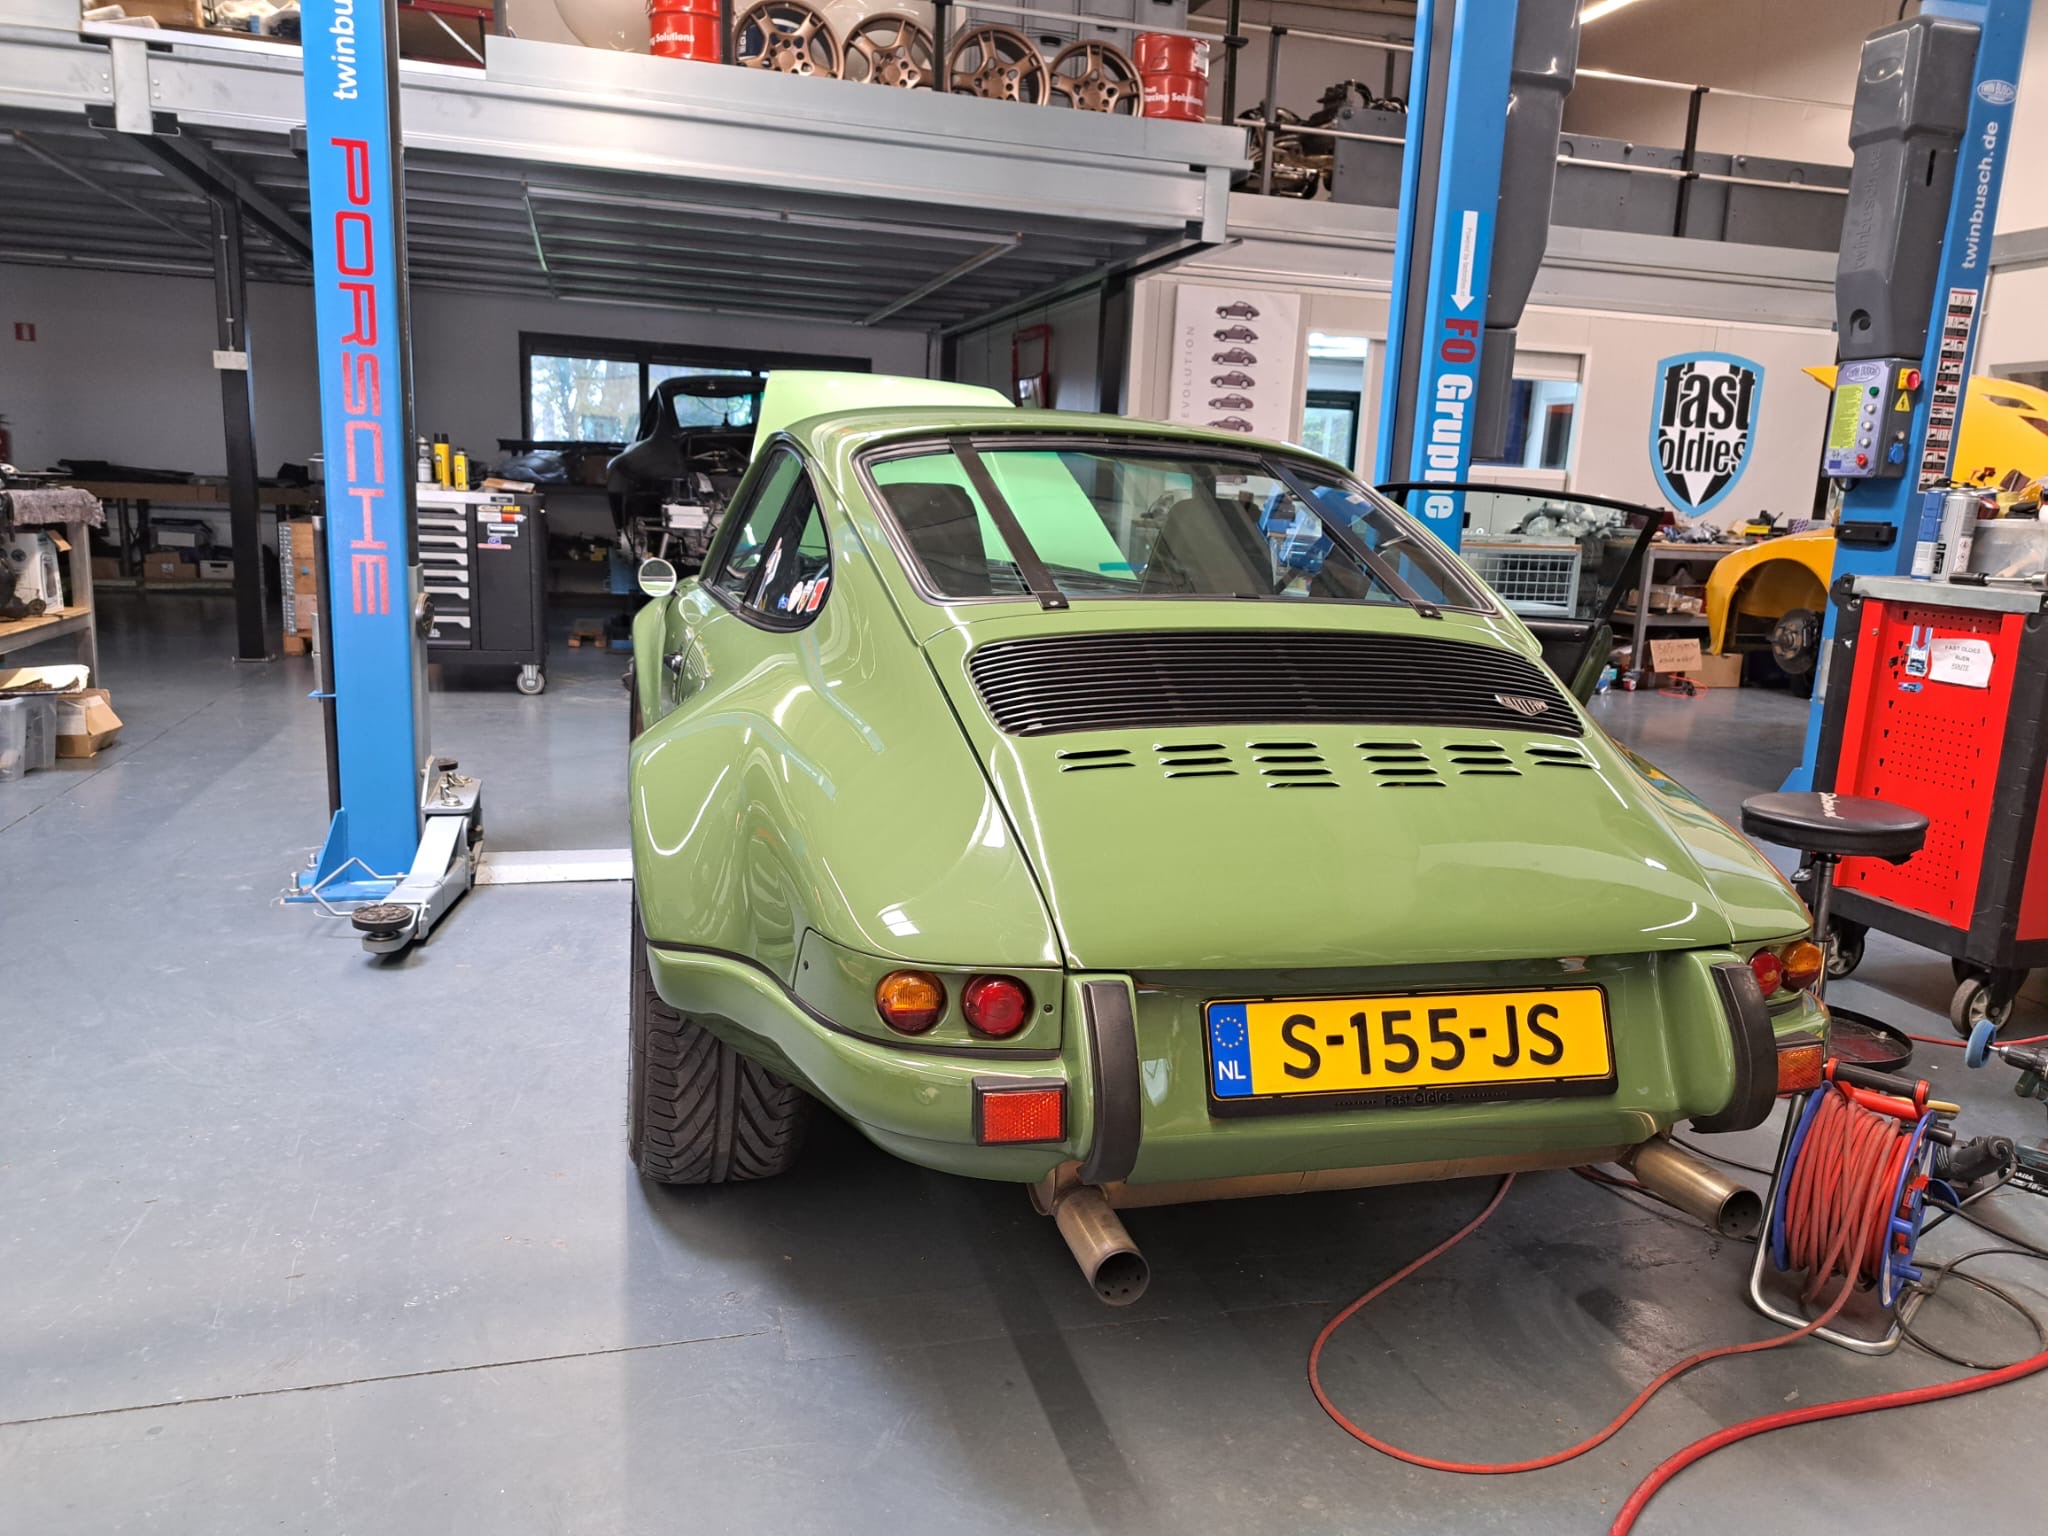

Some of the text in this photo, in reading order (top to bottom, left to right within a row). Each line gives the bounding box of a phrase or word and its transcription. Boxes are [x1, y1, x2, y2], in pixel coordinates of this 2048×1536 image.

[656, 31, 695, 43] Solutions
[1962, 121, 1999, 269] twinbusch.de
[330, 137, 389, 615] PORSCHE
[1181, 326, 1195, 418] EVOLUTION
[1660, 363, 1756, 430] fast
[1424, 318, 1479, 519] FO Gruppe
[1658, 429, 1746, 473] oldies
[1217, 1060, 1247, 1081] NL
[1281, 1004, 1564, 1079] S-155-JS
[1384, 1090, 1455, 1107] Fast Oldies
